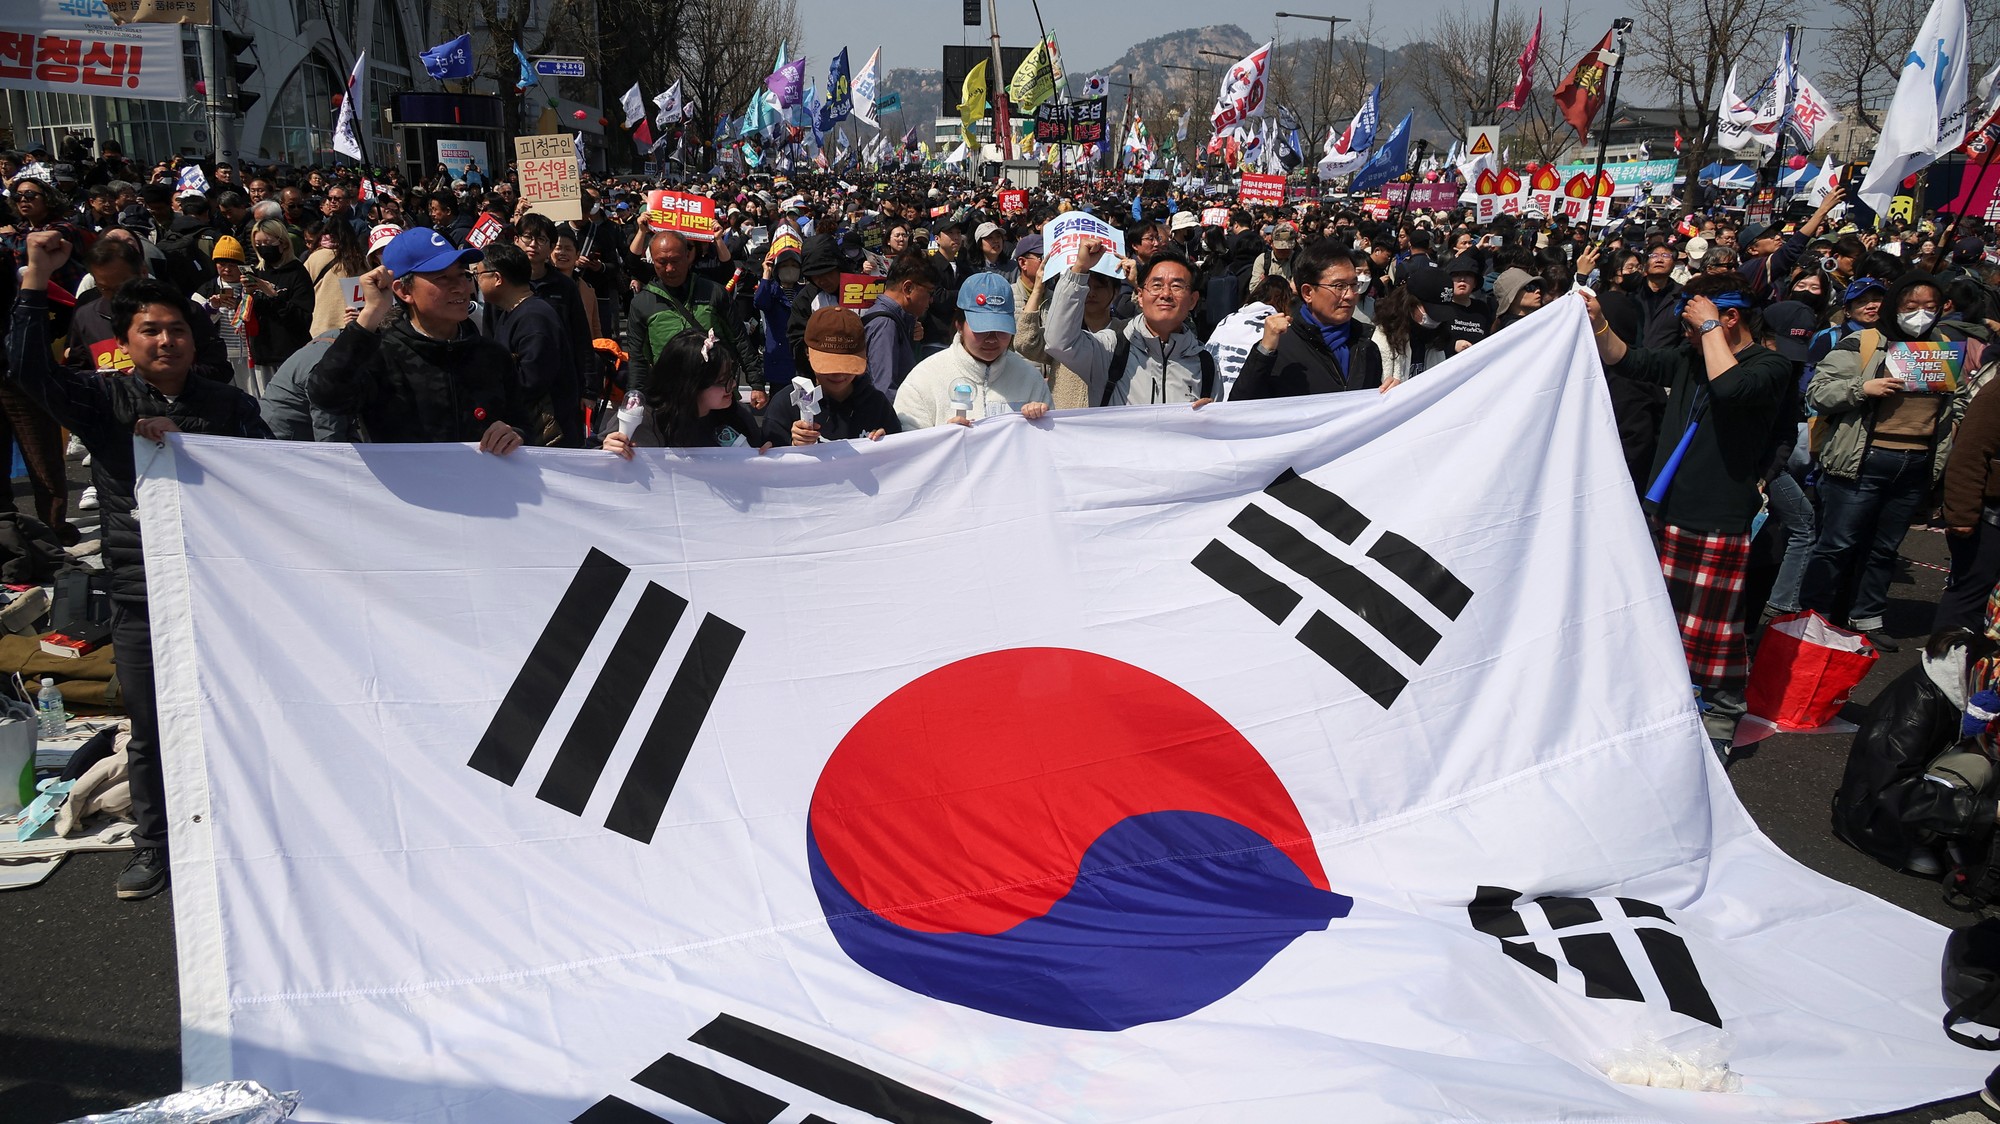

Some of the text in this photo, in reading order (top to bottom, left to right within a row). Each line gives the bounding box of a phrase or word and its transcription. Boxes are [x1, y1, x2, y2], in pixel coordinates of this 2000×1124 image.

[519, 138, 572, 156] 피청구인
[522, 159, 577, 182] 윤석열을
[524, 180, 579, 200] 파면한다
[661, 195, 702, 214] 윤석열
[1480, 200, 1492, 217] 윤
[1565, 199, 1581, 219] 파
[649, 208, 713, 230] 즉각 파면!
[1053, 217, 1109, 240] 윤석열은
[843, 283, 887, 304] 윤석
[1454, 318, 1481, 328] Saturdays
[1892, 349, 1959, 360] 성소수자 차별도
[1905, 361, 1942, 371] 윤석열도
[1919, 372, 1946, 382] 사회로
